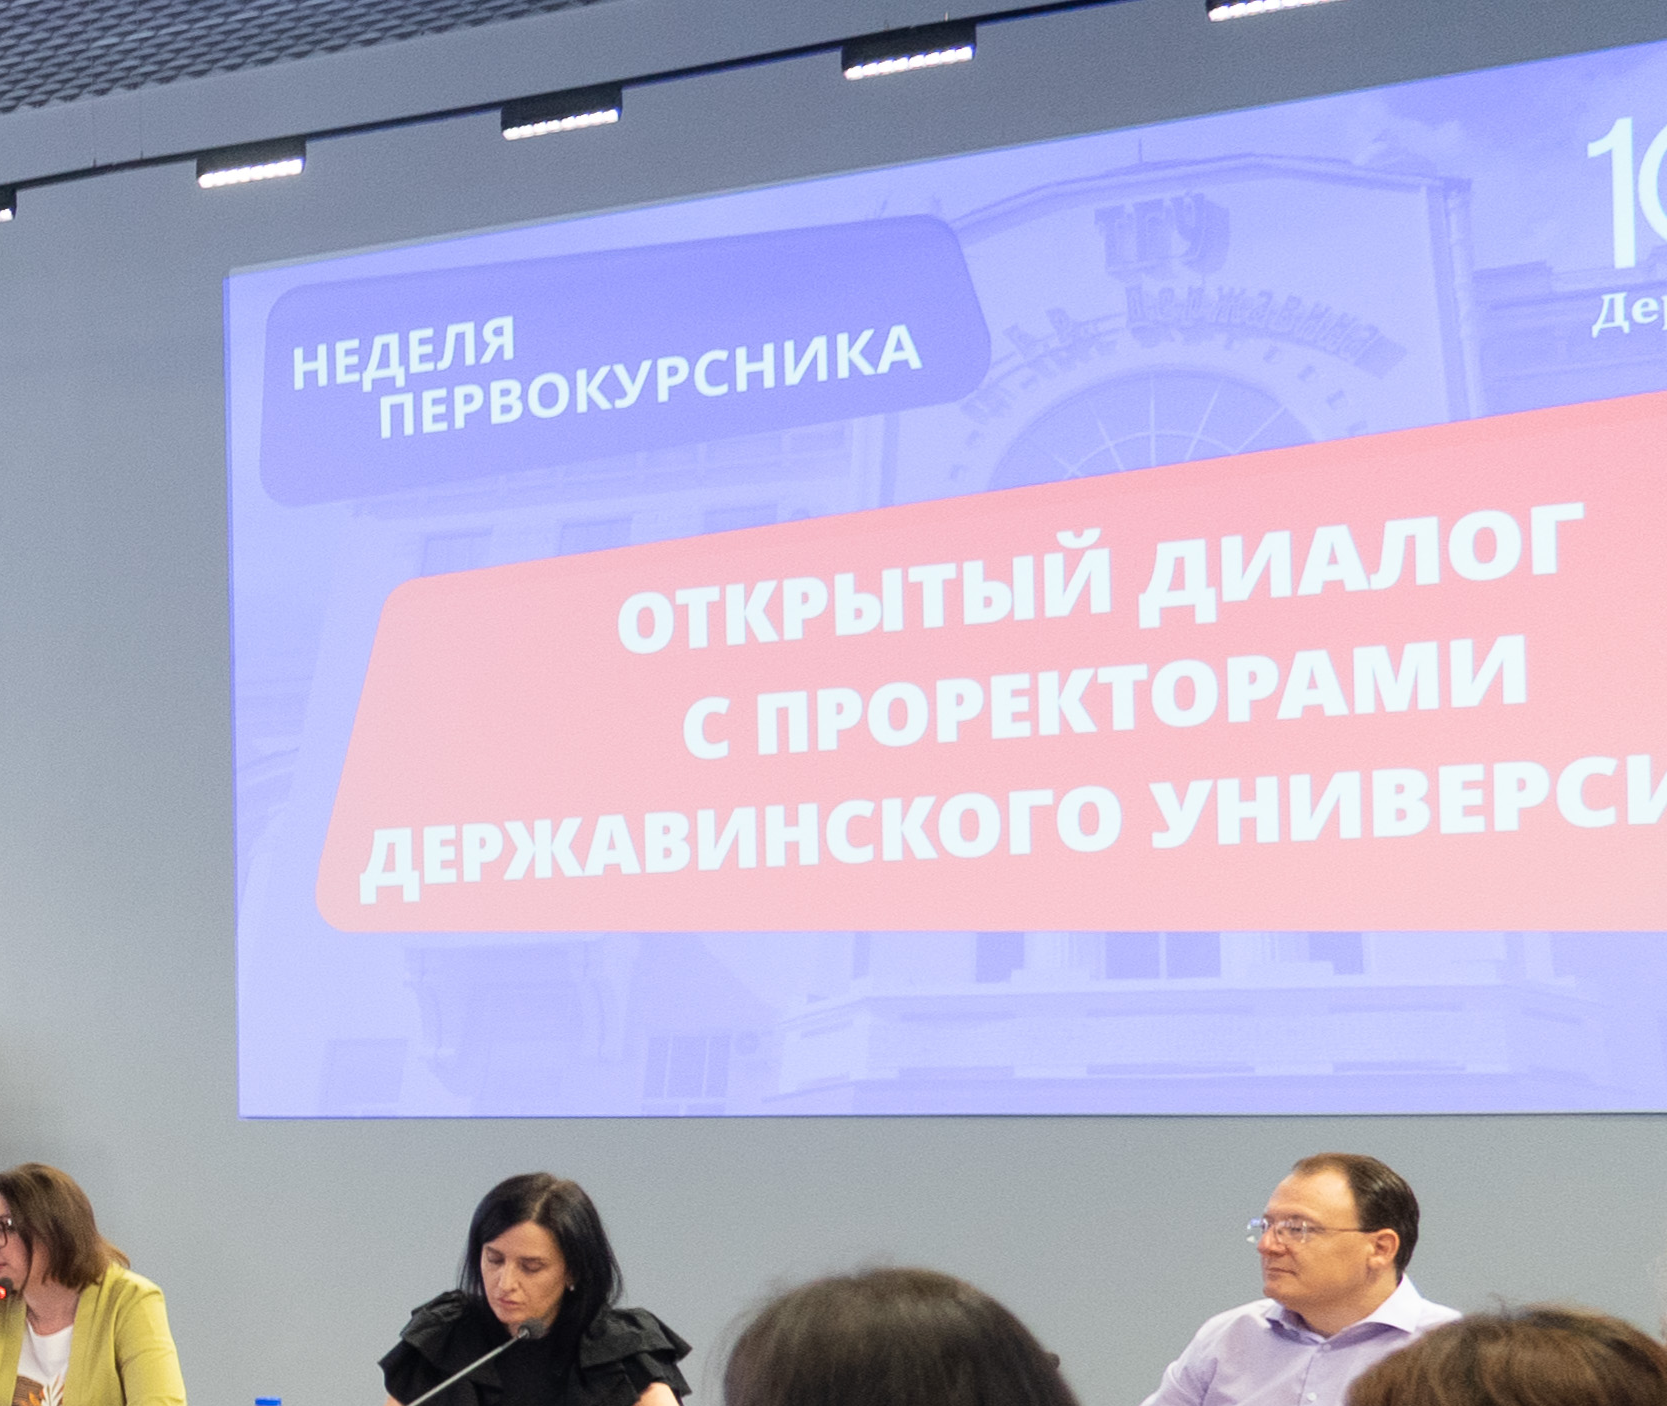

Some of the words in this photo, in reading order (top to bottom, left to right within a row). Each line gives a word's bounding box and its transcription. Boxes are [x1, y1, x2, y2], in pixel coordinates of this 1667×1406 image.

[292, 315, 516, 393] НЕДЕЛЯ
[378, 323, 924, 441] ПЕРВОКУРСНИКА
[616, 527, 1112, 655] ОТКРЫТЫЙ
[1137, 501, 1586, 630] ДИАЛОГ
[682, 696, 731, 761] С
[756, 633, 1528, 757] ПРОРЕКТОРАМИ
[358, 785, 1123, 906] ДЕРЖАВИНСКОГО
